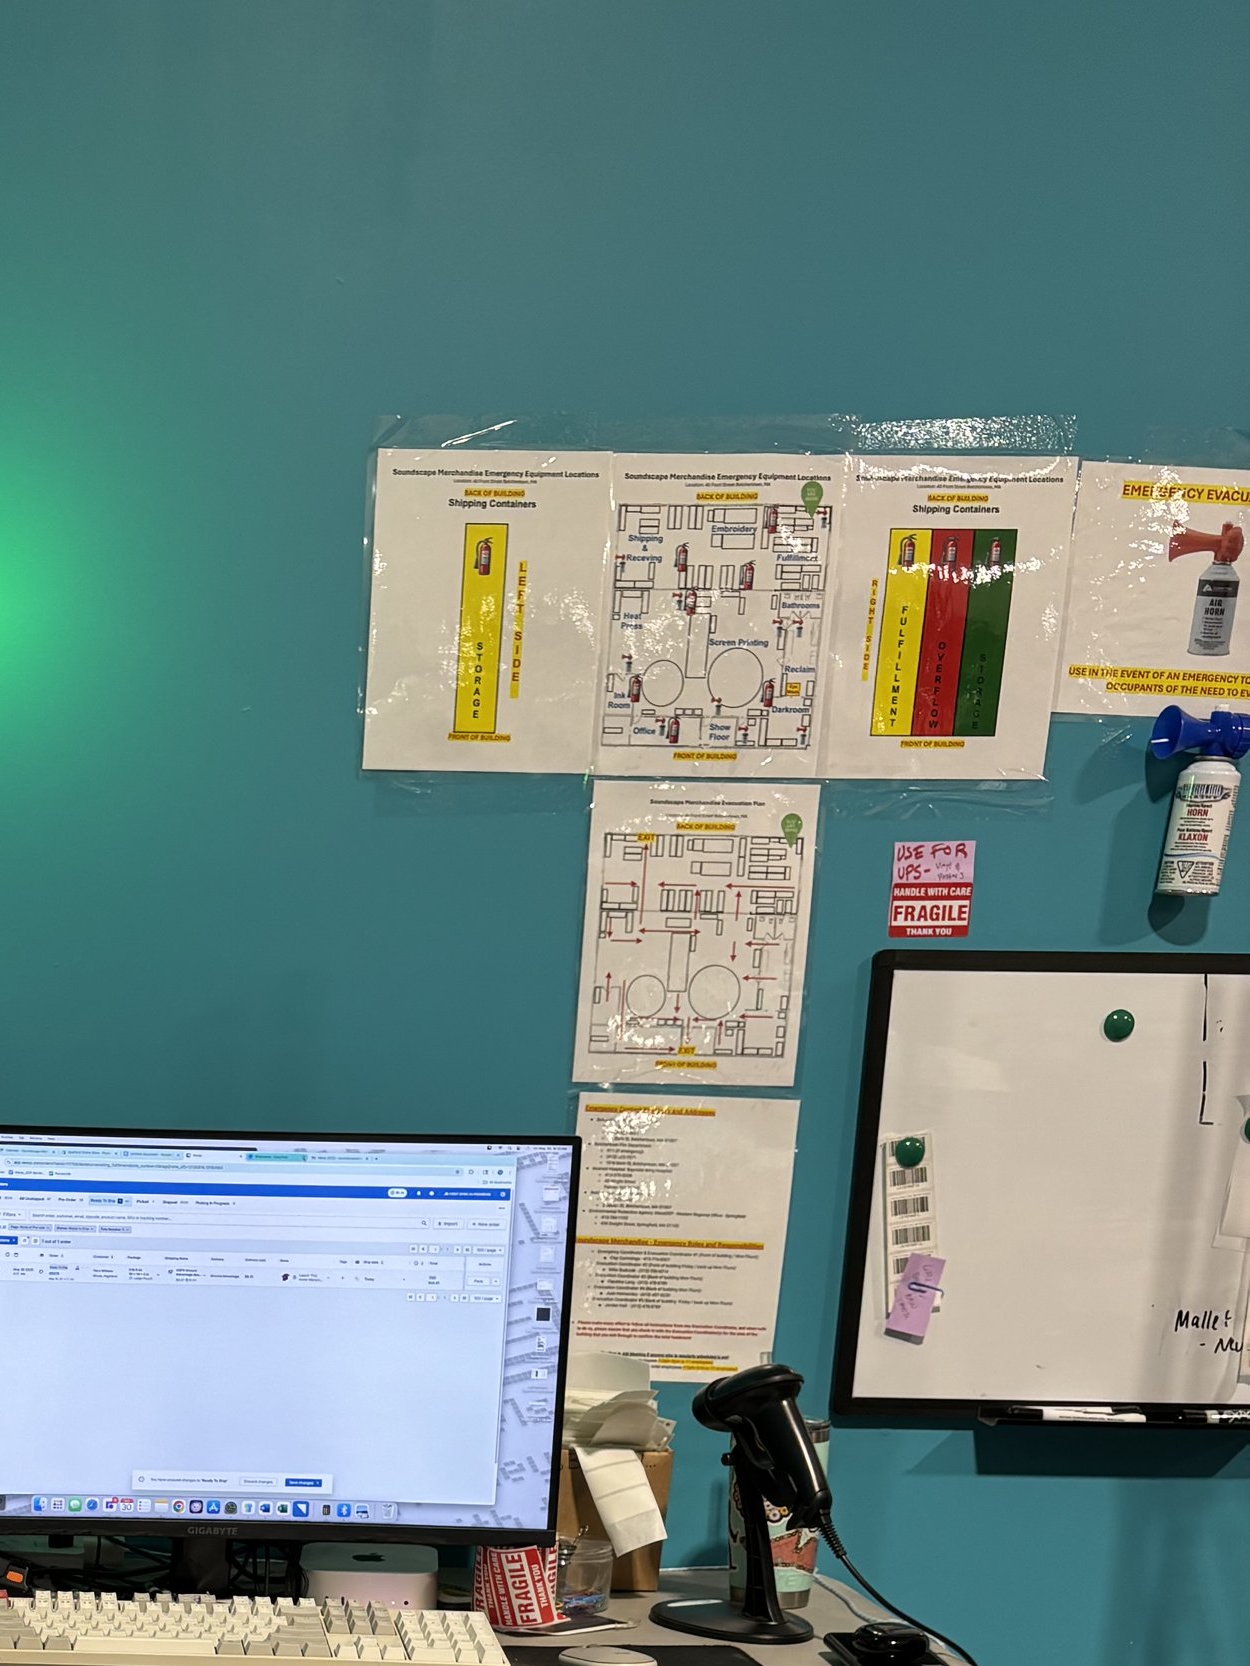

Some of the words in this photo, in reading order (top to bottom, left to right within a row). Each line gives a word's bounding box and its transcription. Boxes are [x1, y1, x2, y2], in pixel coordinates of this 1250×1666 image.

[392, 468, 436, 477] Soundscape
[438, 469, 483, 477] Merchandise
[485, 470, 523, 478] Emergency
[525, 471, 563, 479] Equipment
[624, 473, 669, 481] Soundscape
[670, 473, 716, 481] Merchandise
[717, 474, 757, 482] Emergency
[758, 474, 796, 482] Equipment
[448, 499, 487, 509] Shipping
[489, 500, 537, 508] Containers
[912, 504, 951, 514] Shipping
[952, 505, 1000, 514] Containers
[711, 525, 757, 534] Embroidery
[628, 534, 664, 544] Shipping
[626, 554, 662, 563] Receving
[782, 602, 820, 610] Bathrooms
[1209, 598, 1223, 607] AIR
[1204, 607, 1225, 616] HORN
[709, 638, 736, 647] Screen
[737, 638, 769, 648] Printing
[1068, 666, 1087, 676] USE
[1088, 668, 1098, 676] IN
[1101, 669, 1119, 678] THE
[1120, 670, 1150, 679] EVENT
[1152, 671, 1165, 680] OF
[1167, 672, 1180, 680] AN
[1182, 672, 1239, 684] EMERGENCY
[1106, 681, 1164, 693] OCCUPANTS
[1165, 684, 1179, 693] OF
[1180, 685, 1198, 694] THE
[1199, 686, 1225, 696] NEED
[1226, 688, 1239, 696] TO
[771, 706, 810, 714] Darkroom
[633, 727, 656, 735] Office
[709, 723, 731, 732] Show
[709, 733, 730, 741] Floor
[673, 752, 694, 760] FRONT
[705, 753, 737, 761] BUILDING
[1187, 808, 1209, 817] HORN
[1177, 832, 1208, 842] KLAXON
[897, 844, 926, 862] USE
[930, 843, 968, 859] FOR
[897, 864, 921, 880] UPS
[894, 888, 926, 897] HANDLE
[927, 888, 949, 897] WITH
[950, 887, 972, 896] CARE
[893, 905, 968, 922] FRAGILE
[906, 928, 934, 936] THANK
[935, 928, 952, 936] YOU
[121, 1503, 132, 1511] 30
[187, 1526, 239, 1536] GIGABYTE
[490, 1552, 501, 1573] CARE
[531, 1564, 541, 1581] YOU
[495, 1574, 506, 1595] WITH
[504, 1553, 538, 1624] FRAGILE
[535, 1582, 549, 1608] THANK
[499, 1595, 513, 1625] HANDLE
